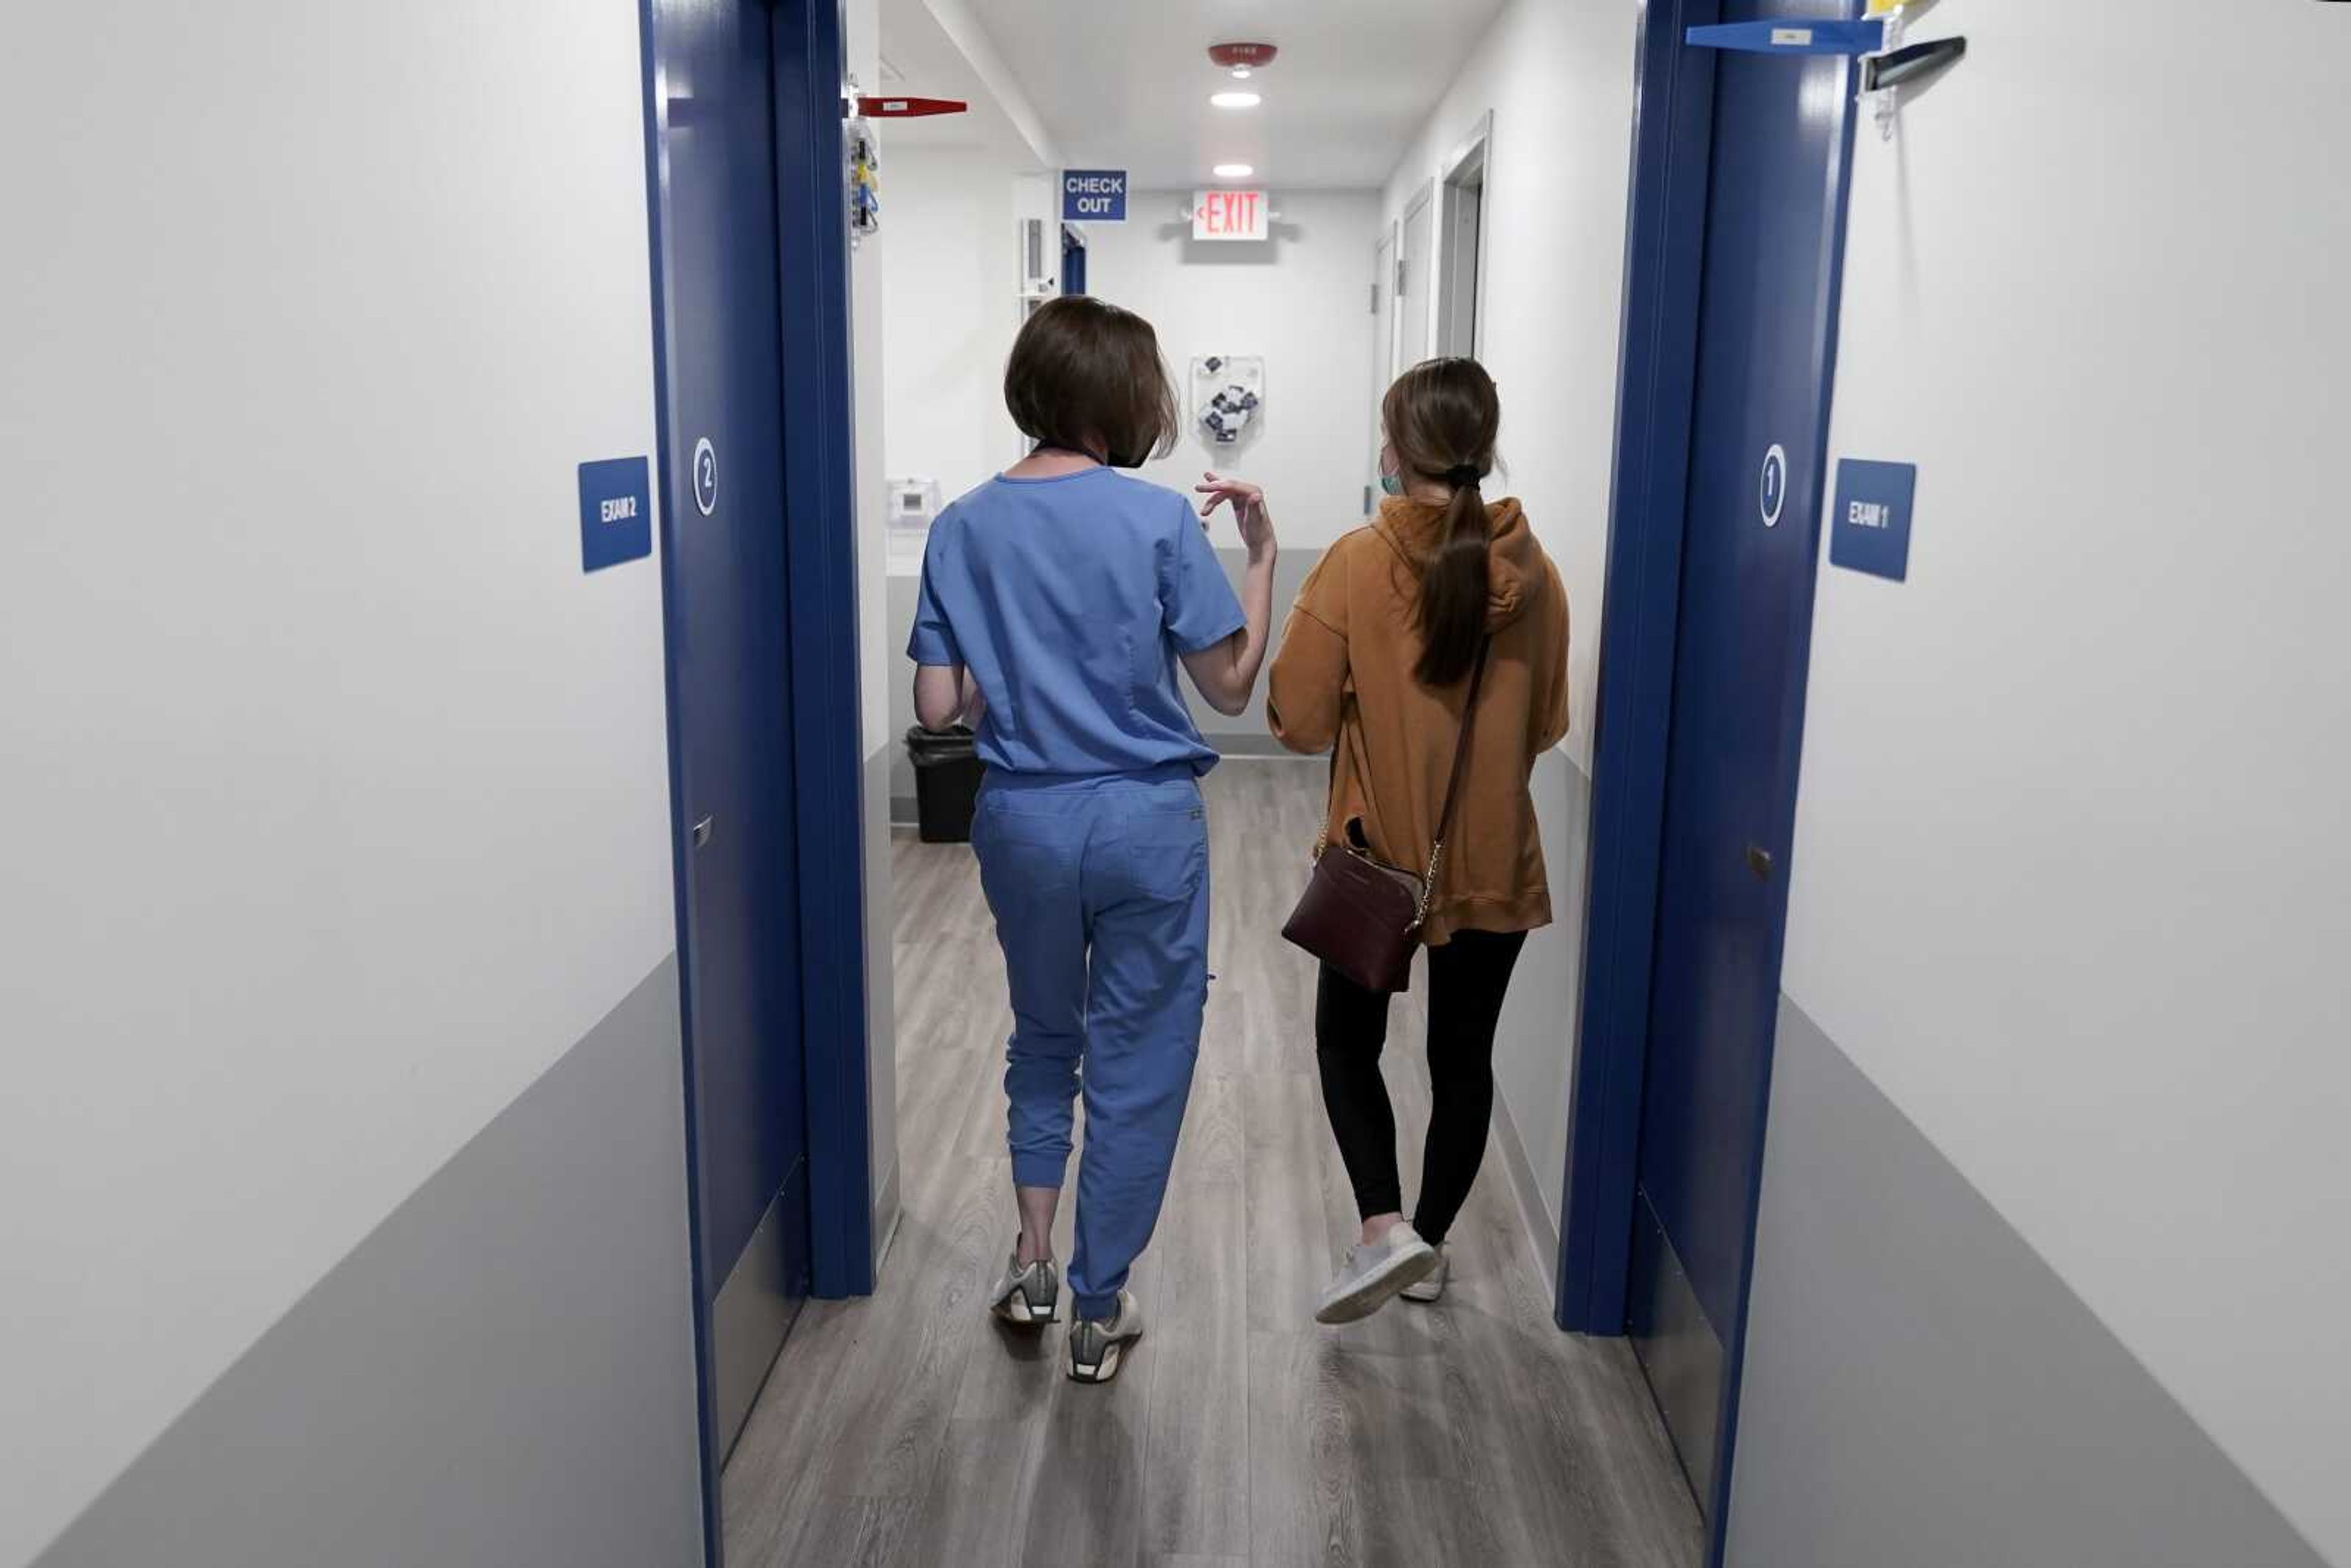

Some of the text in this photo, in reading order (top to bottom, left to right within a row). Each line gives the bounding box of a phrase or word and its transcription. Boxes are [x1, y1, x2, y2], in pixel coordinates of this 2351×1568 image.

[1067, 177, 1123, 193] CHECK
[1078, 197, 1111, 212] OUT
[1207, 192, 1259, 233] EXIT
[703, 457, 712, 487] 2
[1768, 463, 1775, 496] 1
[601, 496, 636, 522] EXAM 2
[1849, 501, 1889, 529] EXAM 1
